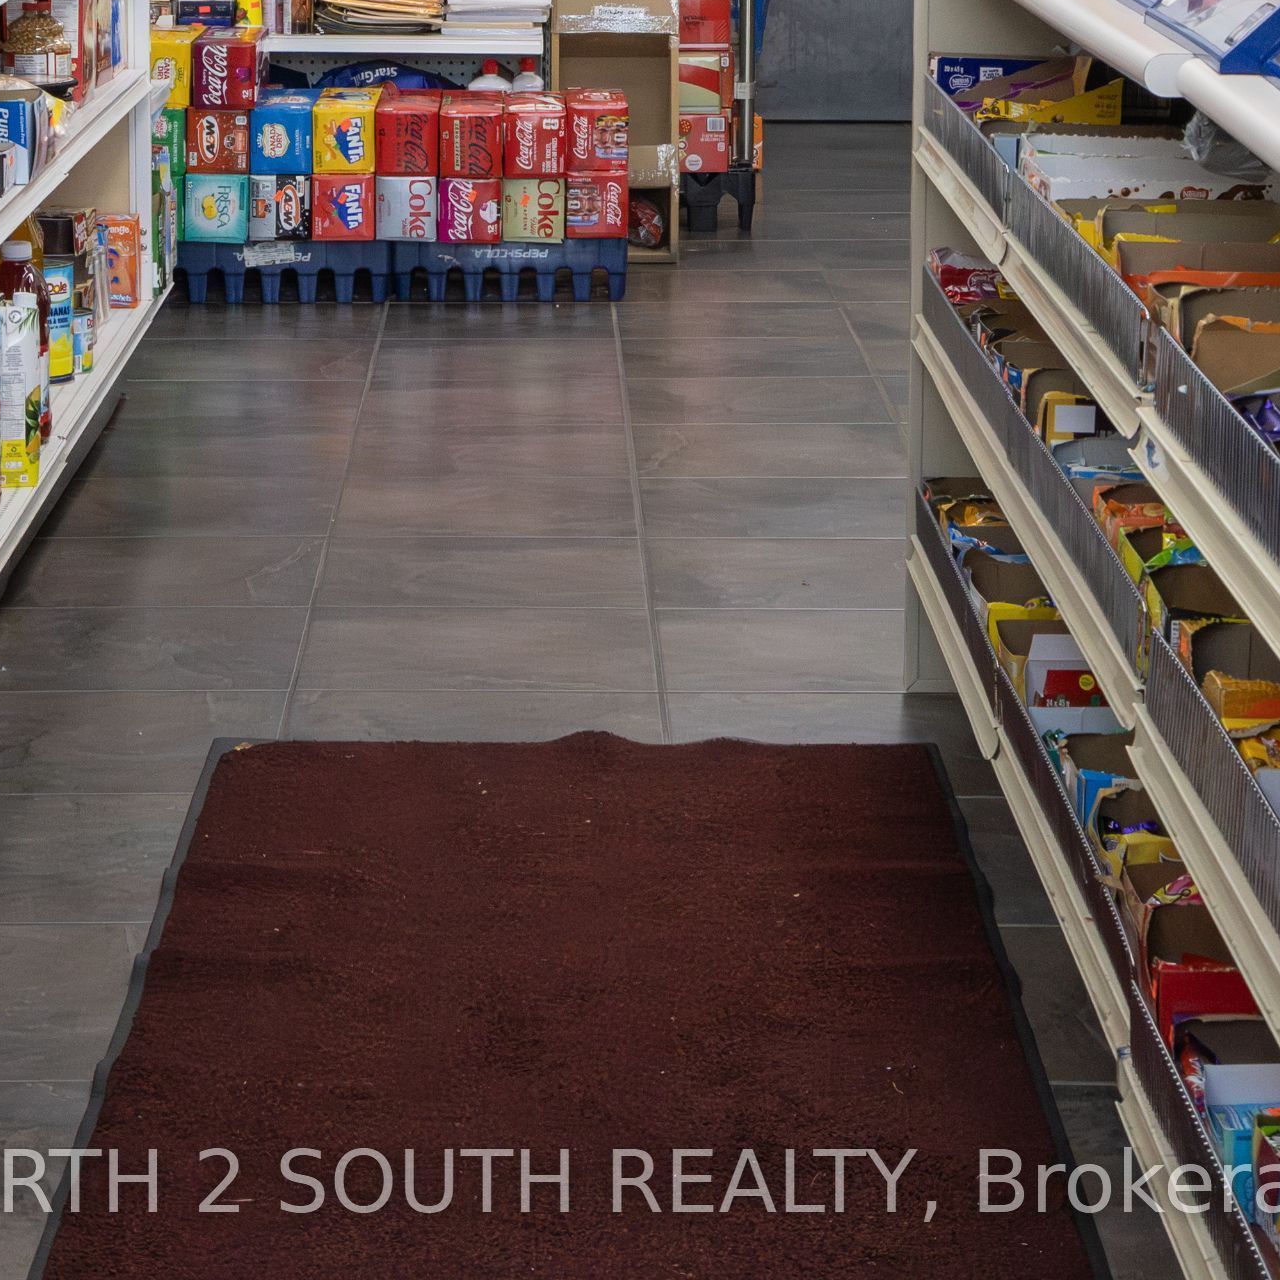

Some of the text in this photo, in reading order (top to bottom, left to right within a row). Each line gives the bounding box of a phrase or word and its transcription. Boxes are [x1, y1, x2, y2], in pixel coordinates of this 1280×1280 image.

[202, 44, 228, 105] Coca-Cola
[348, 117, 364, 164] FANTA
[217, 185, 233, 229] FRESCA
[344, 184, 361, 230] FANTA
[408, 179, 433, 239] Coke
[537, 179, 561, 239] Coke
